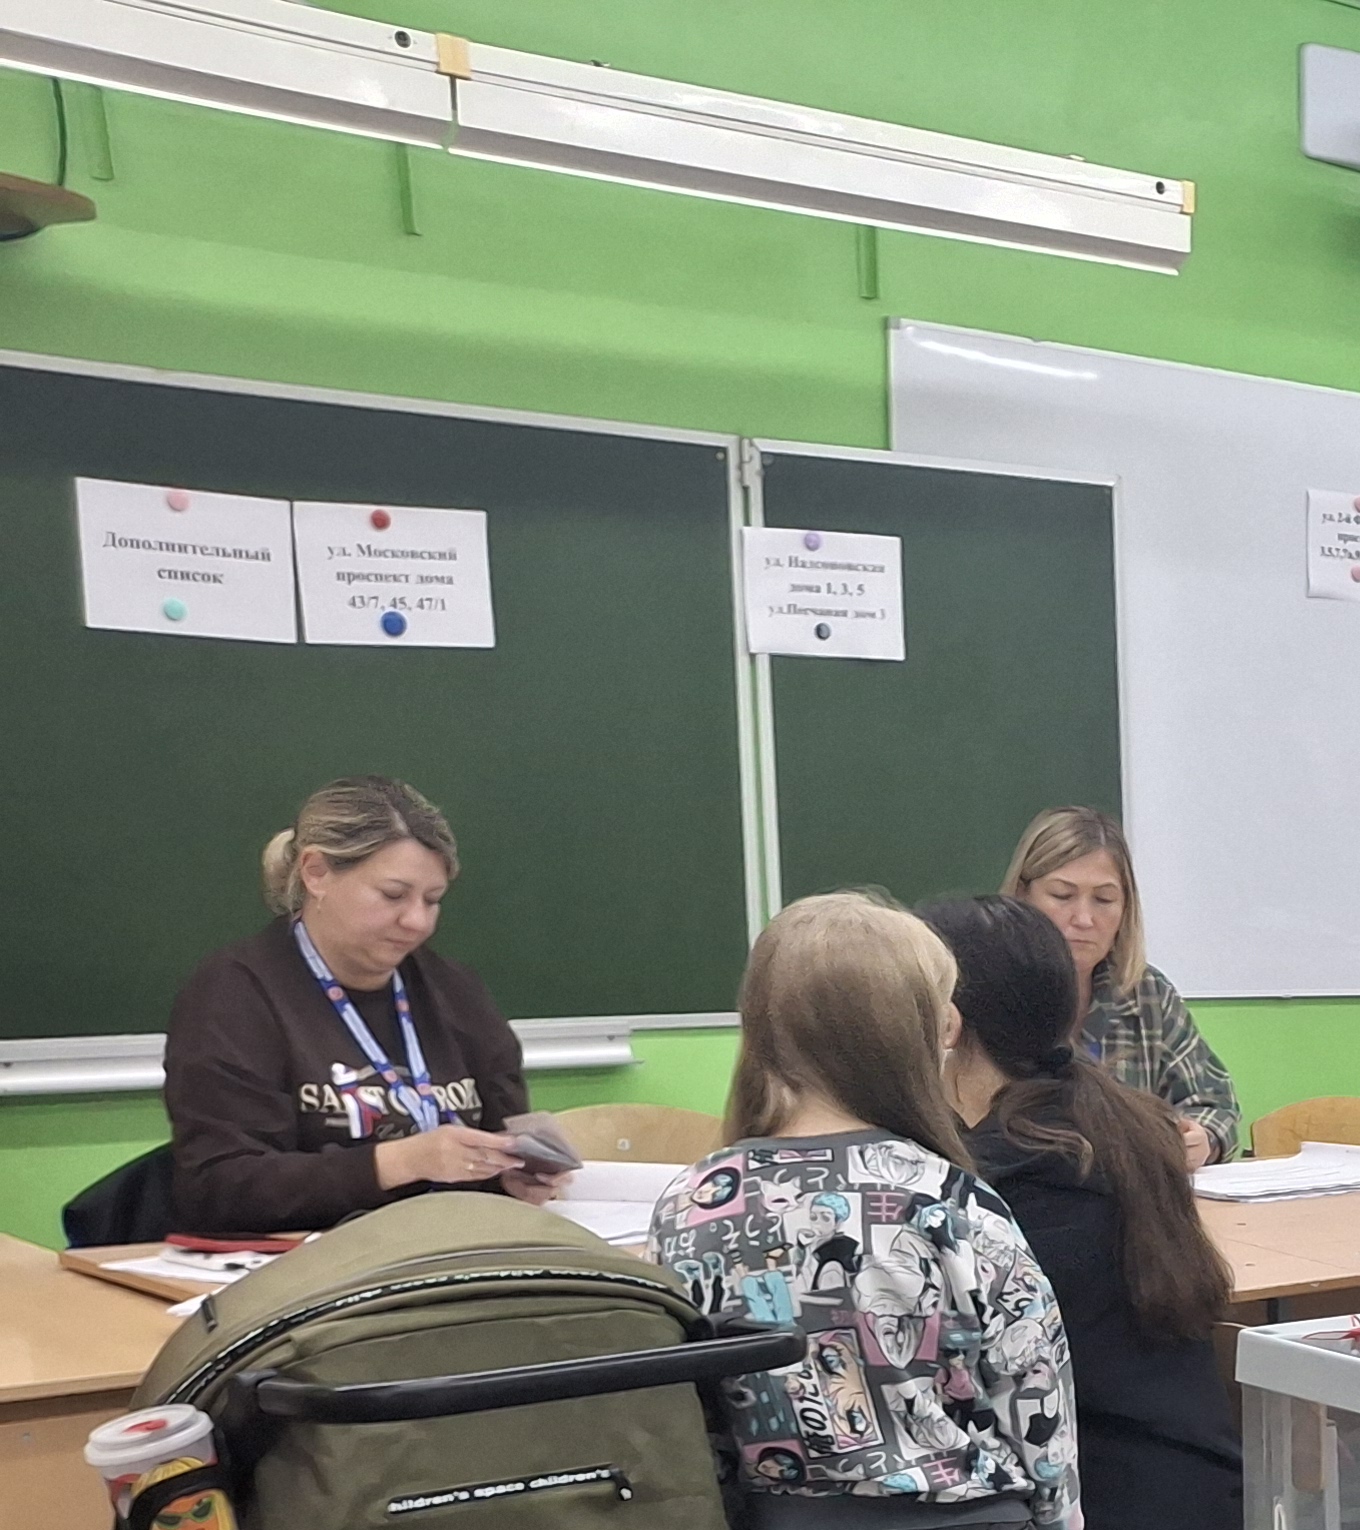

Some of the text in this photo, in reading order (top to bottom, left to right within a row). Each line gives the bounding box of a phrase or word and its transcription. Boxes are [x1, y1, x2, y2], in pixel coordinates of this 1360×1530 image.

[102, 531, 272, 562] Дополнительный
[327, 543, 458, 561] ул. Московский
[157, 567, 224, 585] список
[336, 571, 454, 585] проспект дома
[856, 583, 865, 597] 5
[348, 595, 447, 611] 43/7, 45, 47/1
[474, 1482, 525, 1498] space
[529, 1469, 611, 1489] children's
